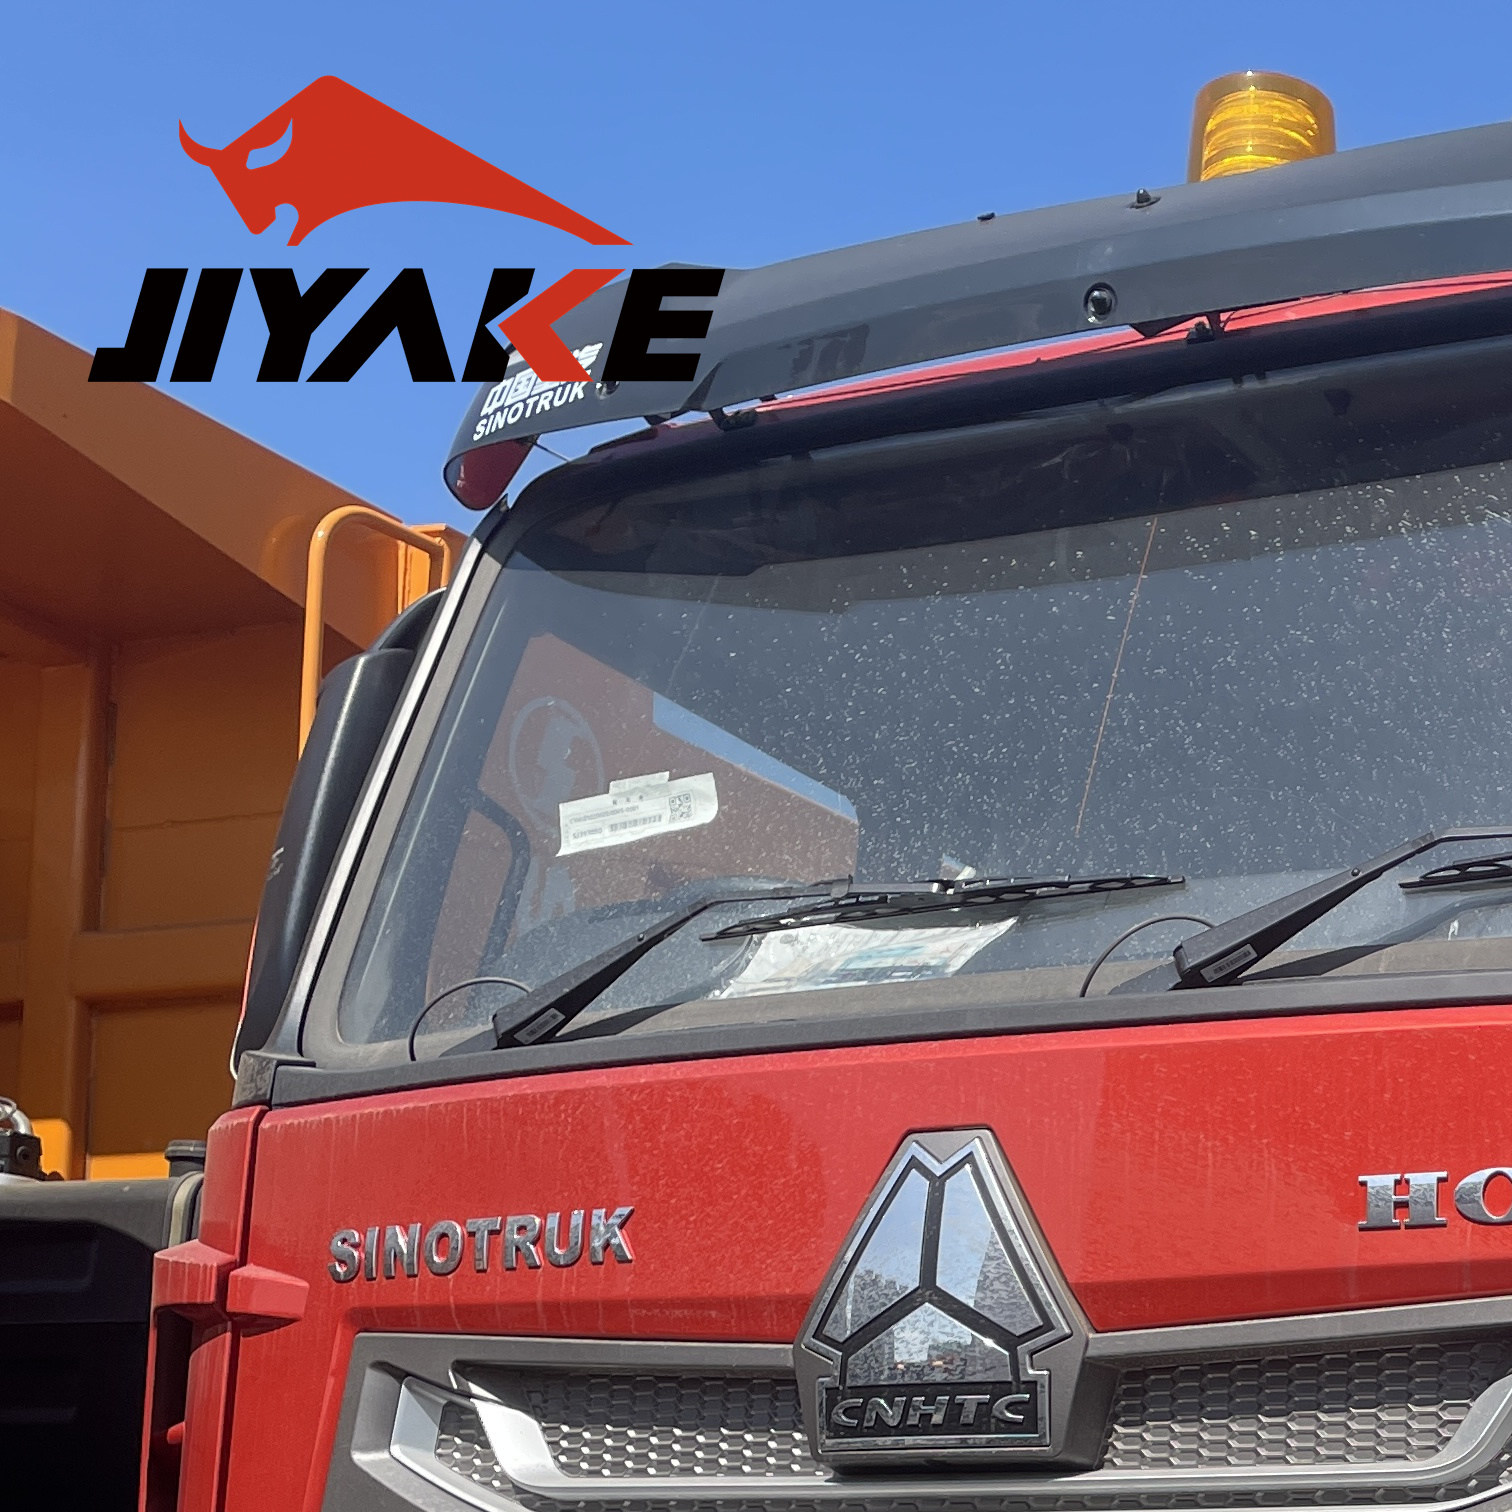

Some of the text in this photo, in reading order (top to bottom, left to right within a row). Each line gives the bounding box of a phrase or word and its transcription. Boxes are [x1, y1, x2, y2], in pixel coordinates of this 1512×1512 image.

[472, 384, 586, 441] SINOTRUK
[327, 1206, 636, 1283] SINOTRUK
[830, 1393, 1031, 1430] CNHTC
